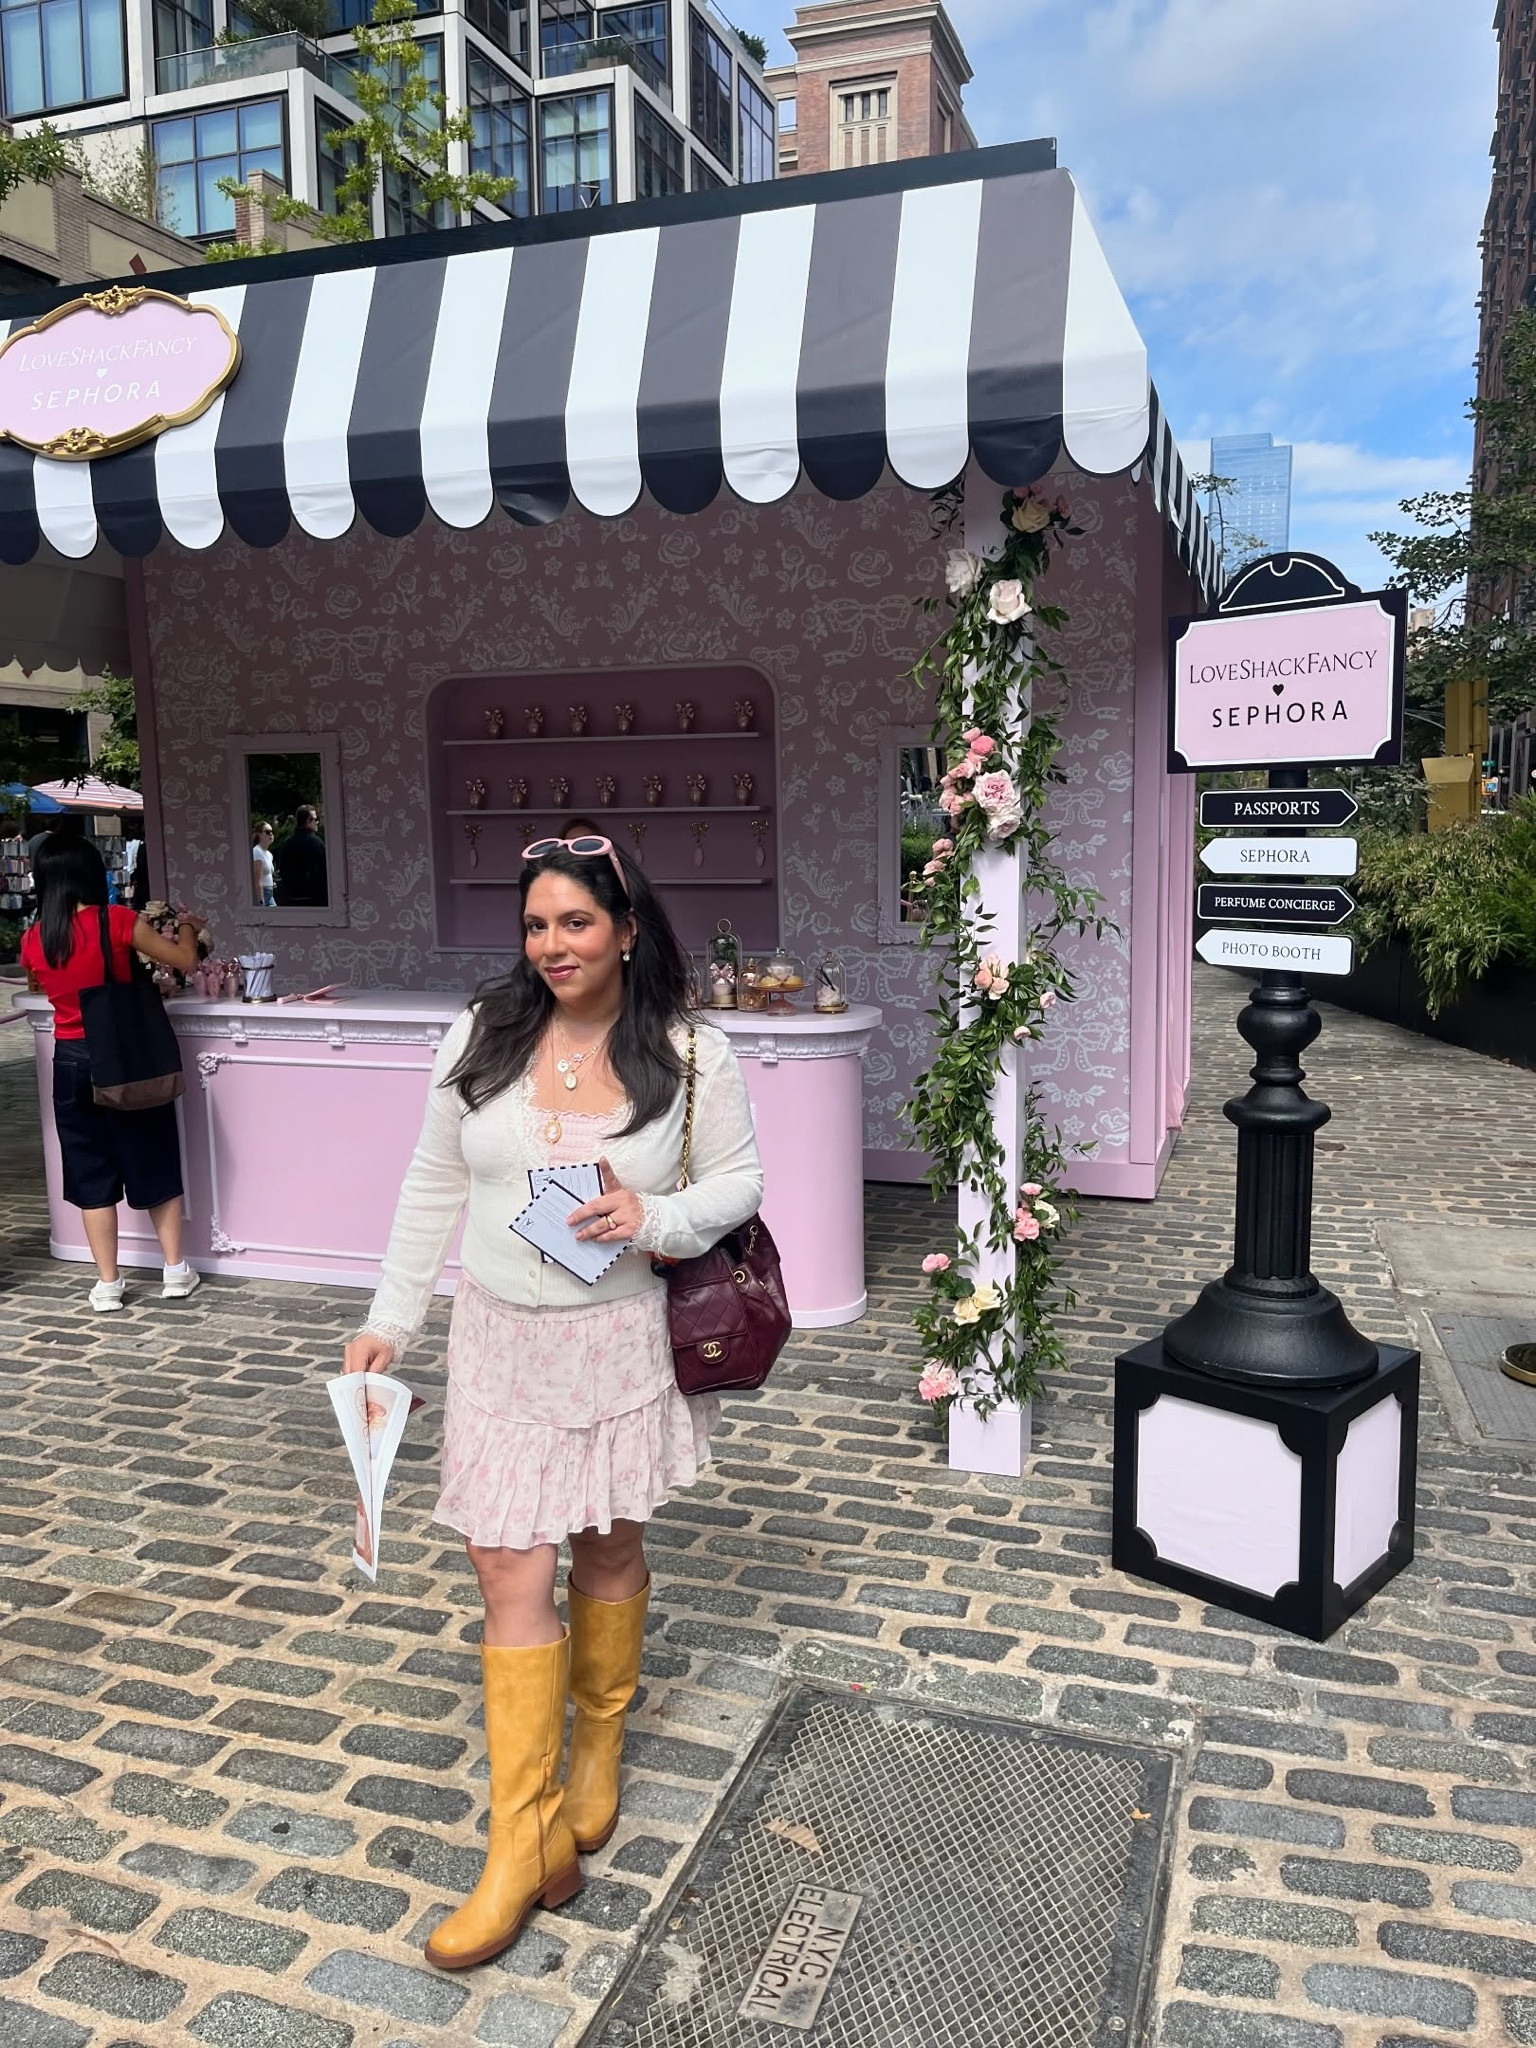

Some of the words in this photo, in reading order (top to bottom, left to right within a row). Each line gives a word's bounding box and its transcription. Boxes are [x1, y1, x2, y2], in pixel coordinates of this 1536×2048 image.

[19, 337, 197, 371] LOVESHACKFANCY
[31, 381, 160, 411] SEPHORA
[1190, 650, 1377, 684] LOVESHACKFANCY
[1212, 700, 1348, 728] SEPHORA
[1233, 801, 1320, 816] PASSPORTS
[1240, 849, 1310, 863] SEPHORA
[1214, 896, 1266, 909] PERFUME
[1268, 898, 1336, 911] CONCIERGE
[1222, 941, 1269, 957] PHOTO
[1272, 945, 1321, 960] BOOTH
[750, 1887, 827, 2010] ELECTRICAL
